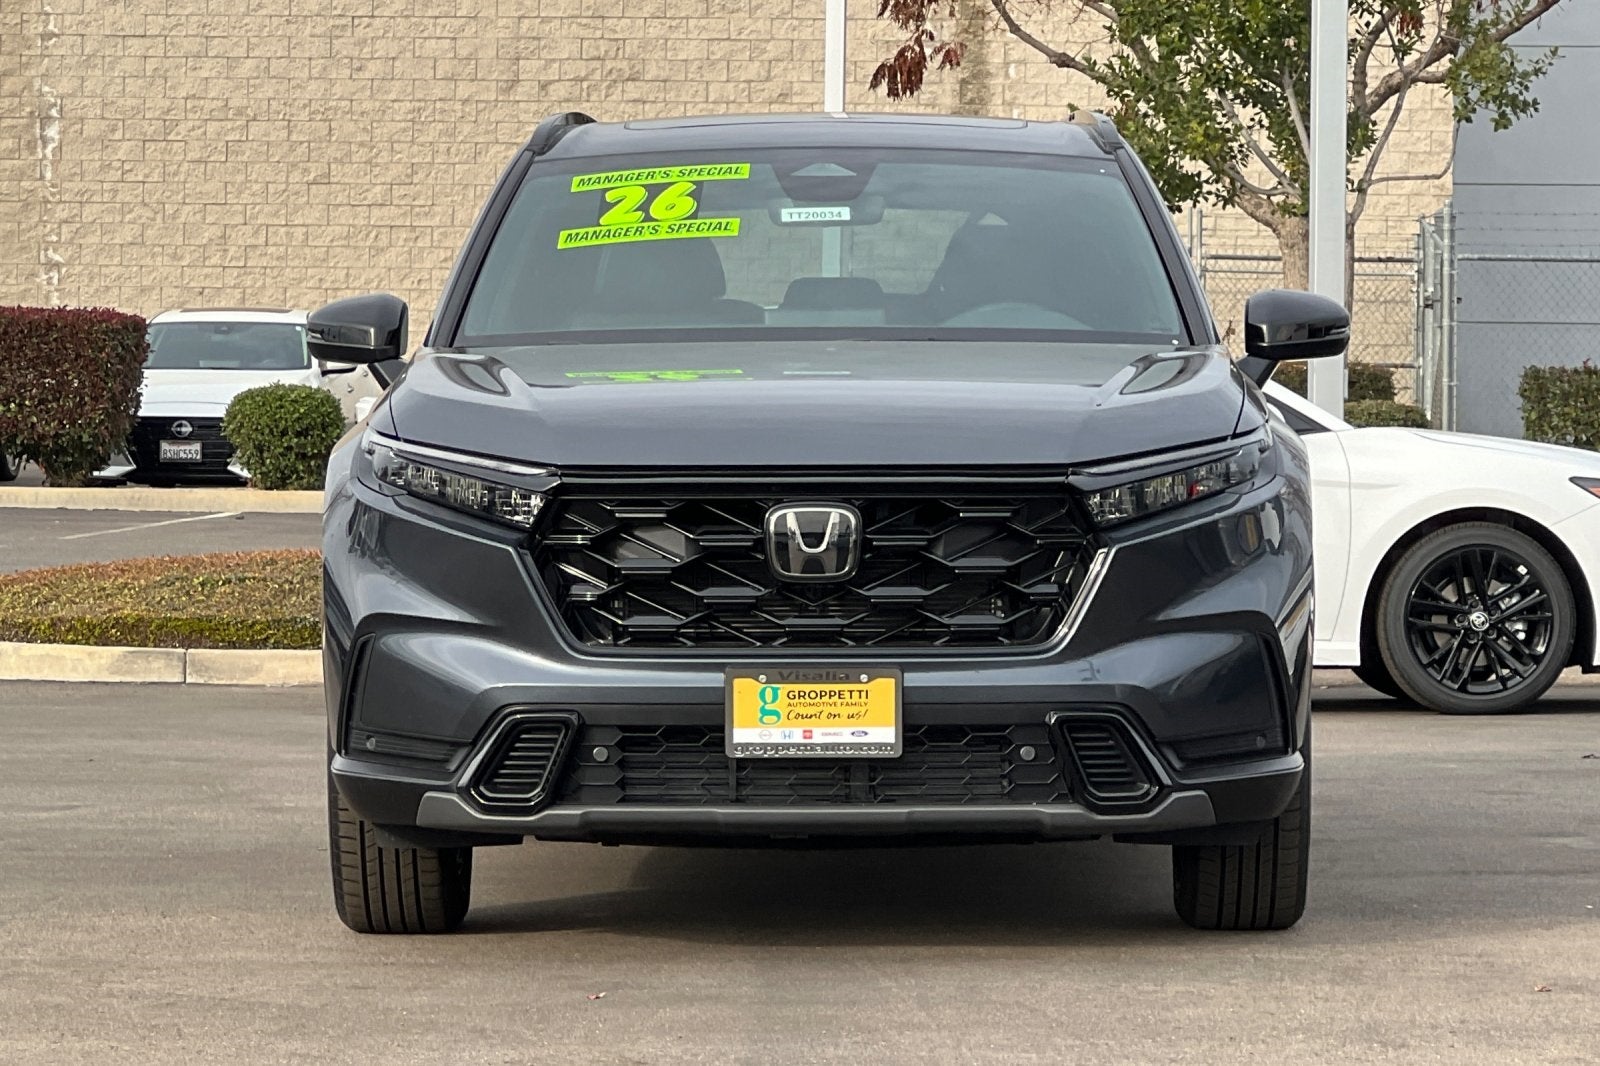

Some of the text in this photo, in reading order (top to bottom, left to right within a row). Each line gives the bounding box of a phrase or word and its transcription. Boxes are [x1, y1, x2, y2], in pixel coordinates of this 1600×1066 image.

[576, 165, 745, 187] MANAGER'S SPECIAL
[599, 181, 698, 226] 26
[787, 211, 842, 220] TT20034
[564, 221, 735, 244] MANAGER'S SPECIAL
[777, 670, 850, 681] Visalia
[786, 689, 869, 700] GROPPETTI
[786, 709, 824, 721] Count
[847, 709, 869, 720] us!
